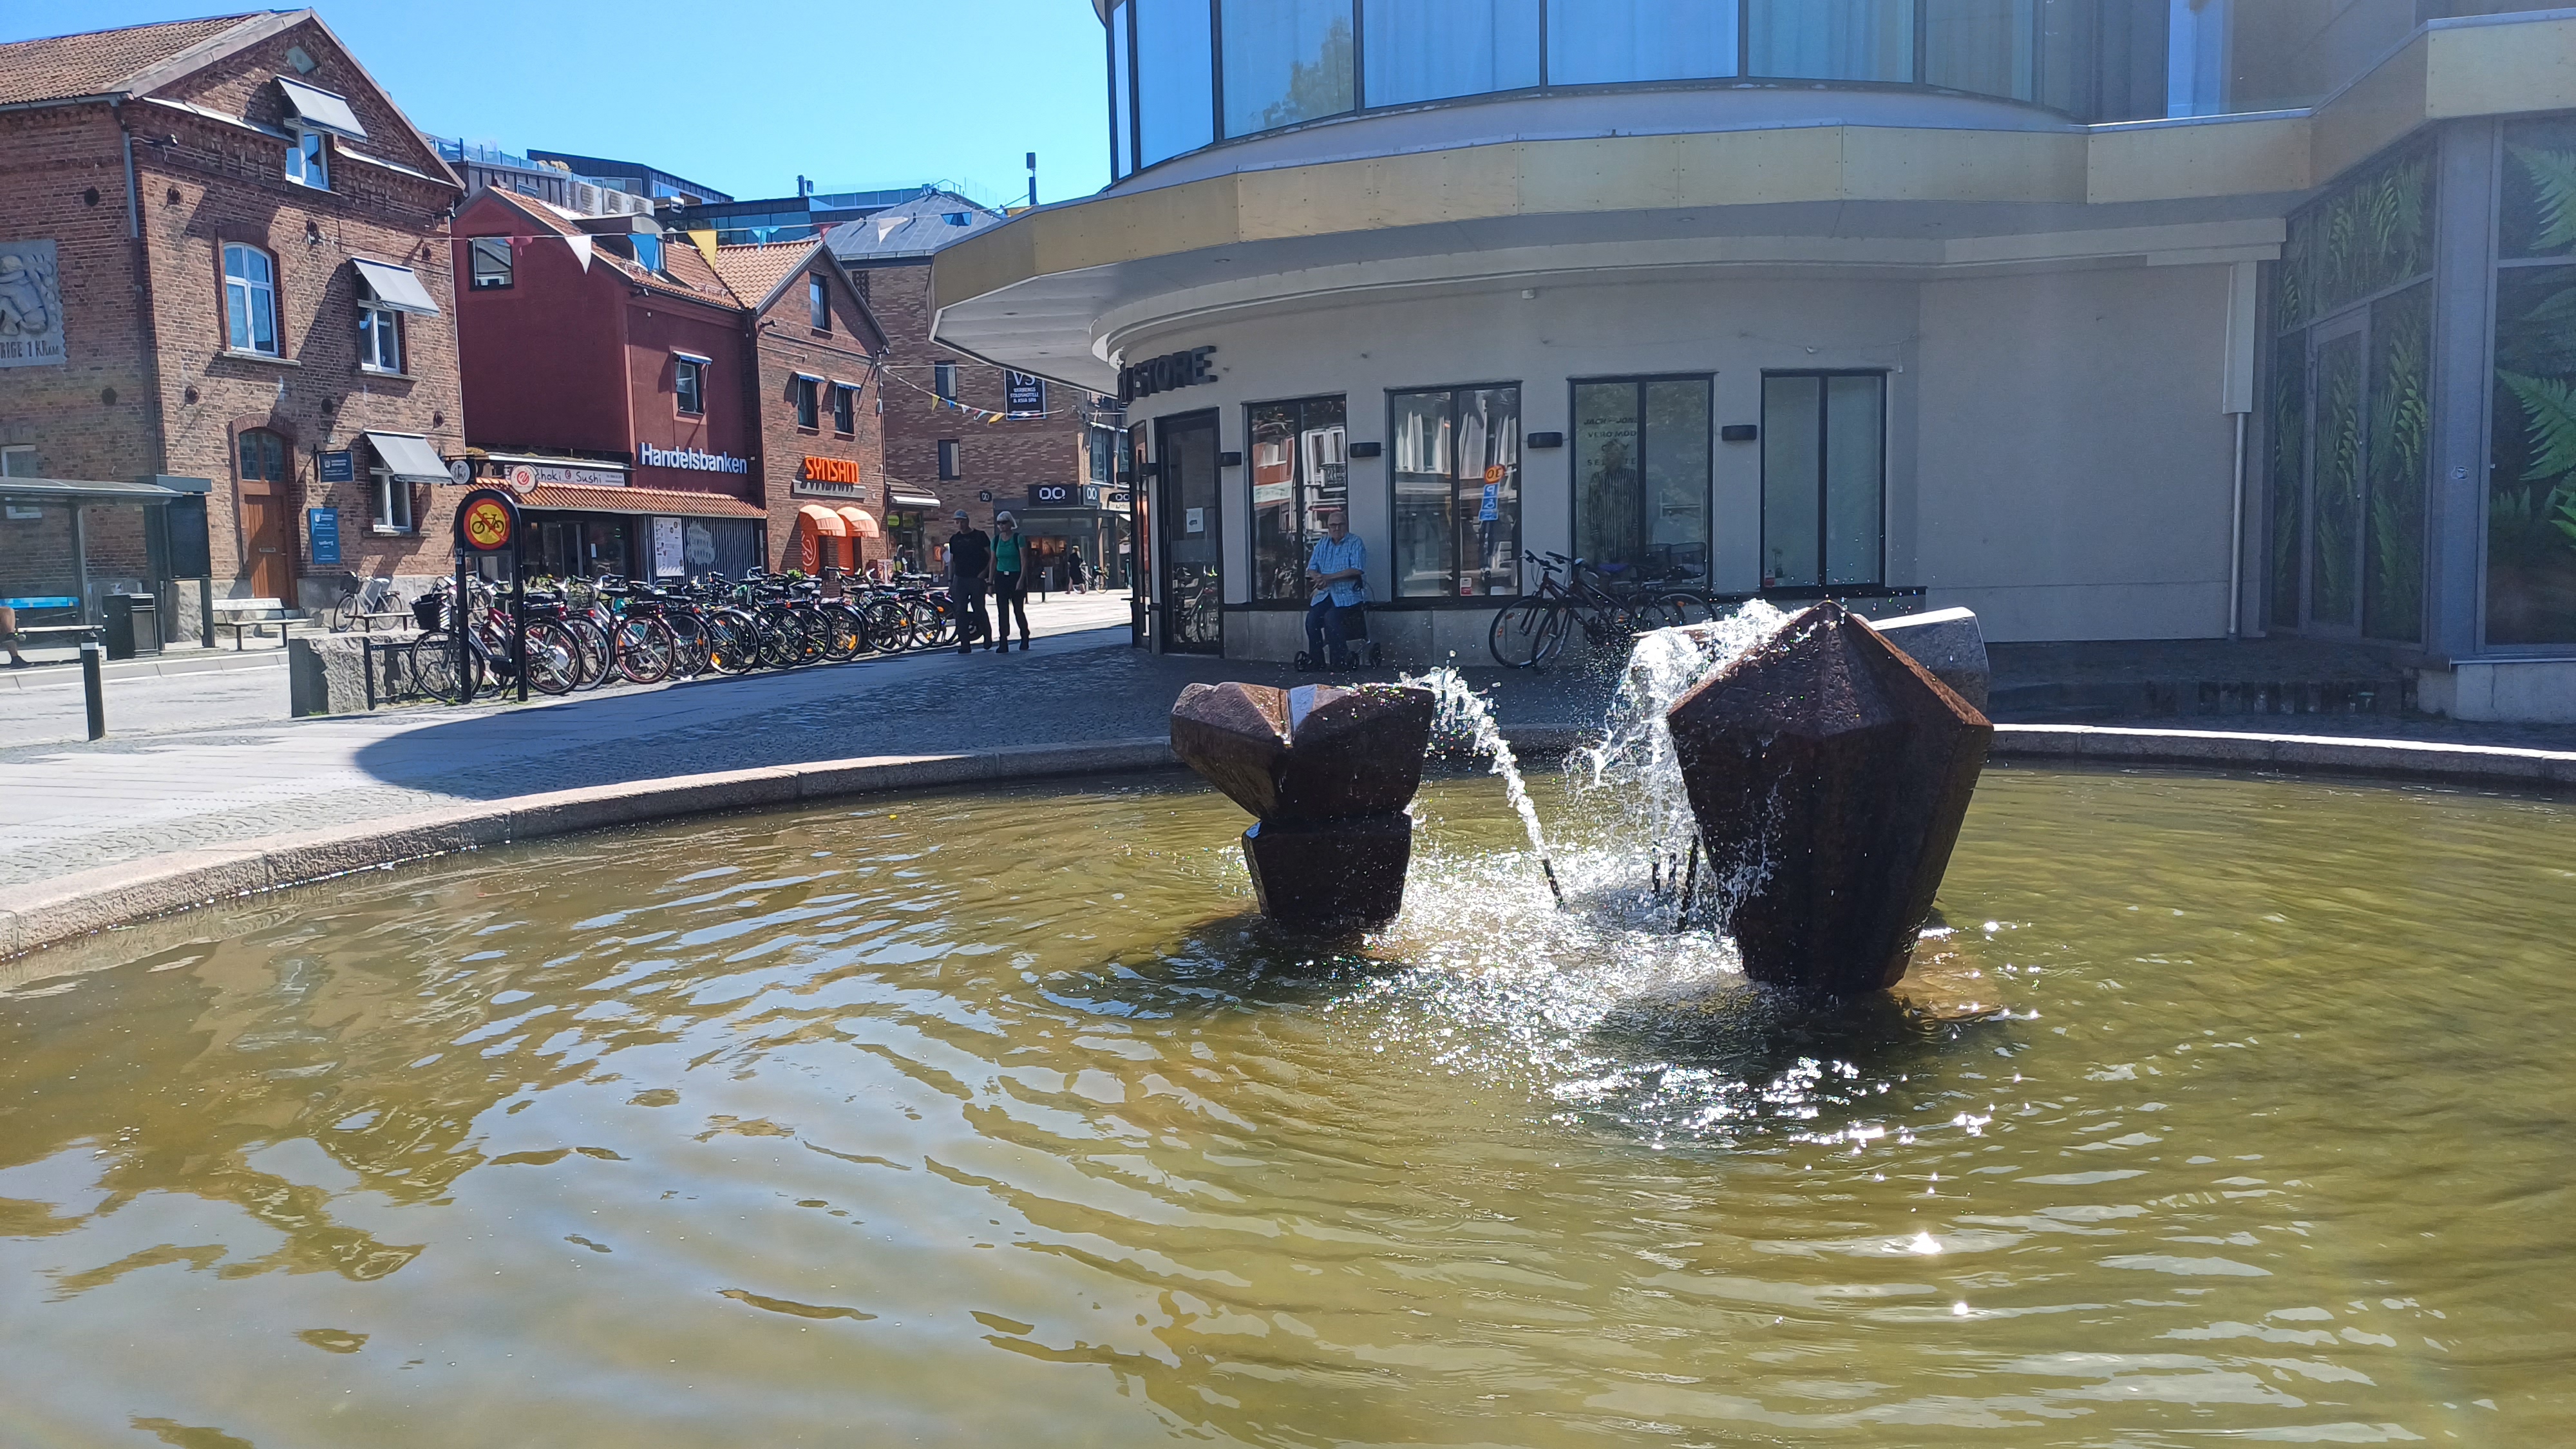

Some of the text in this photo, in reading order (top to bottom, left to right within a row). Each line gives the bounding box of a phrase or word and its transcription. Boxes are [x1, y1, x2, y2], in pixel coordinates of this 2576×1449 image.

[27, 341, 32, 357] 1
[639, 442, 747, 474] Handelsbanken
[576, 471, 601, 484] Sushi
[805, 455, 859, 484] SYNSAM
